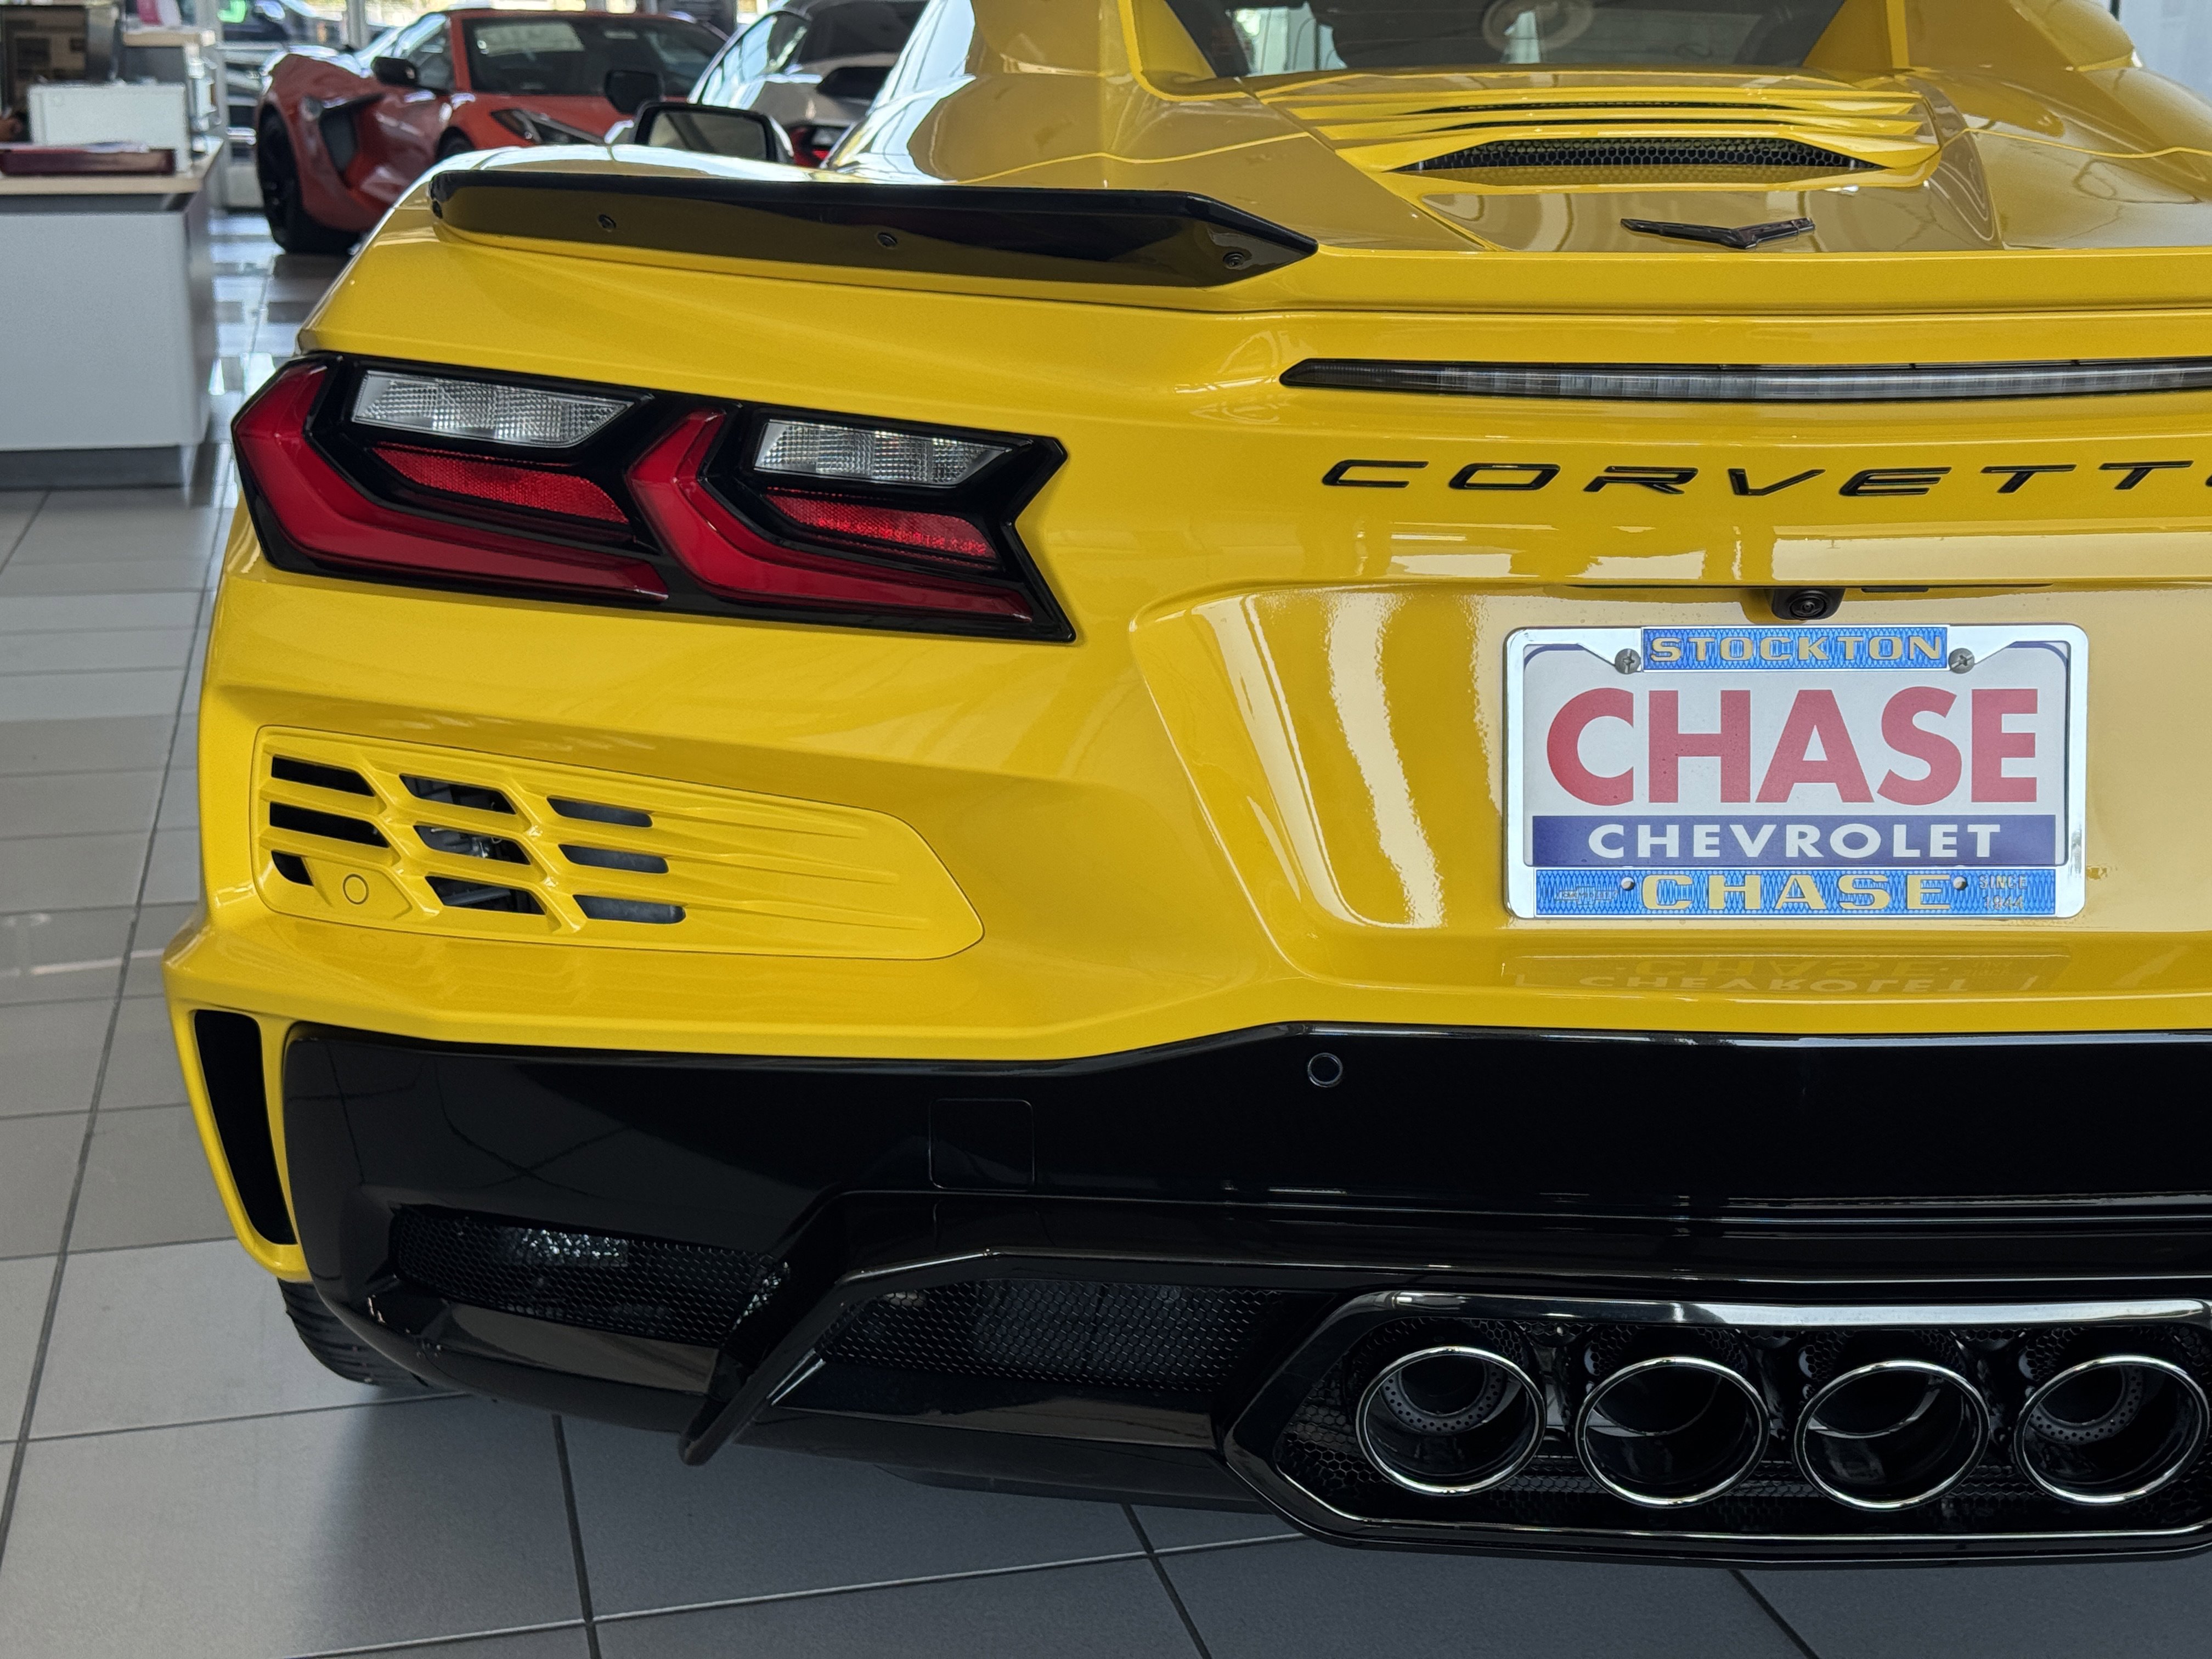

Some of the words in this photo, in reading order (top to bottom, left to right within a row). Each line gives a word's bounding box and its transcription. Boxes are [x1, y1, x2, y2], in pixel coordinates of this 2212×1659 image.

[1321, 459, 2212, 496] CORVETT
[1650, 636, 1942, 661] STOCKTON
[1546, 686, 2039, 806] CHASE
[1588, 823, 2000, 859] CHEVROLET
[1643, 874, 1951, 911] CHASE
[1978, 874, 2028, 889] SINCE
